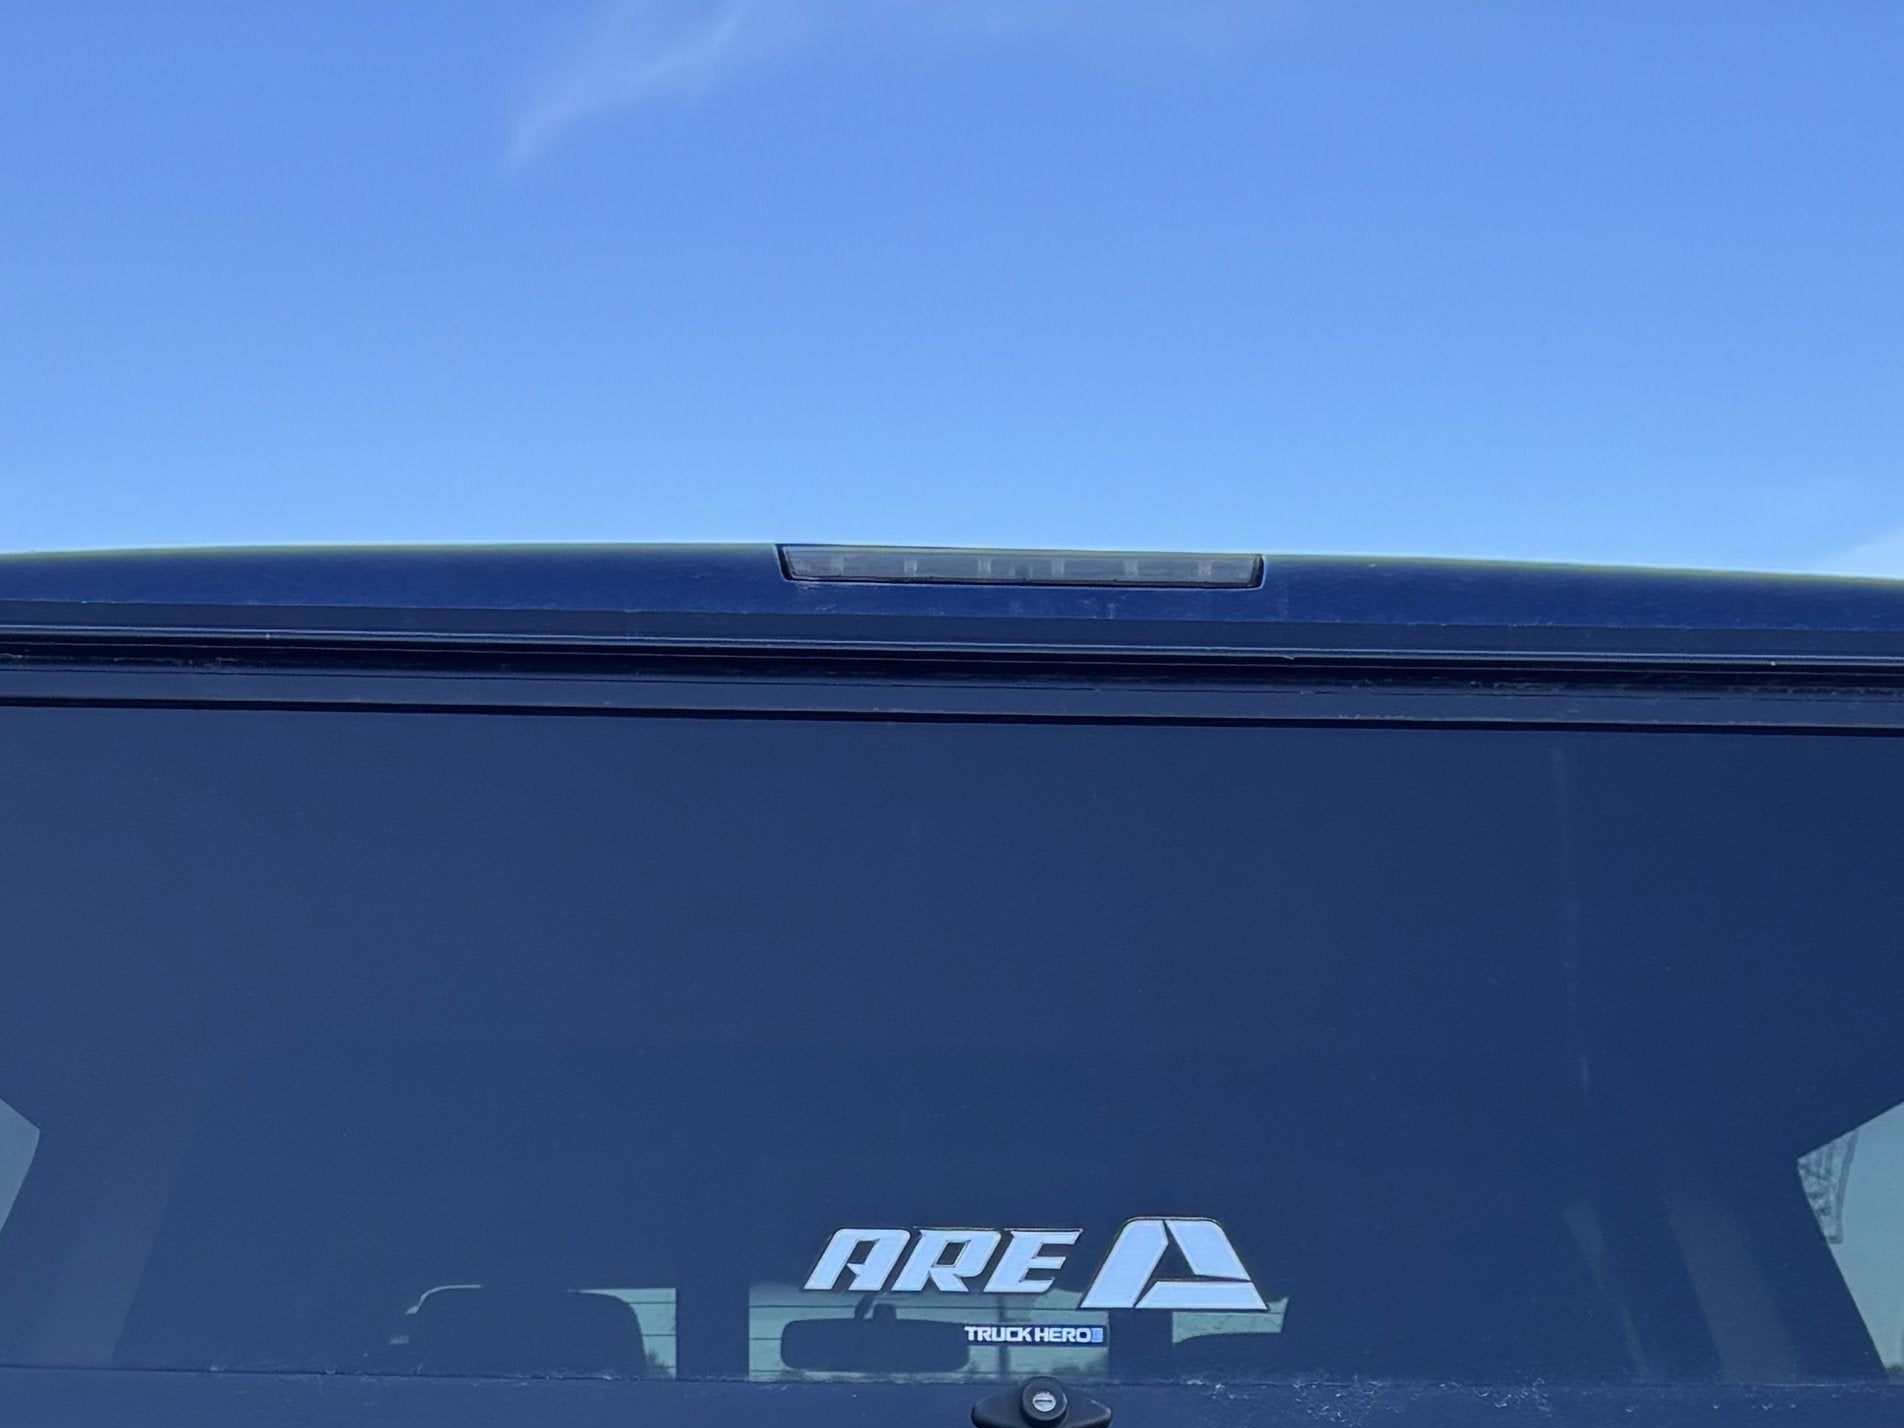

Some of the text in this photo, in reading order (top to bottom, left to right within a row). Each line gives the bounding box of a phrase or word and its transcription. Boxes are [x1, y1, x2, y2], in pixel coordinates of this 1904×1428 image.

[803, 1227, 1083, 1294] ARE
[964, 1326, 1092, 1343] TRUCK HERO
